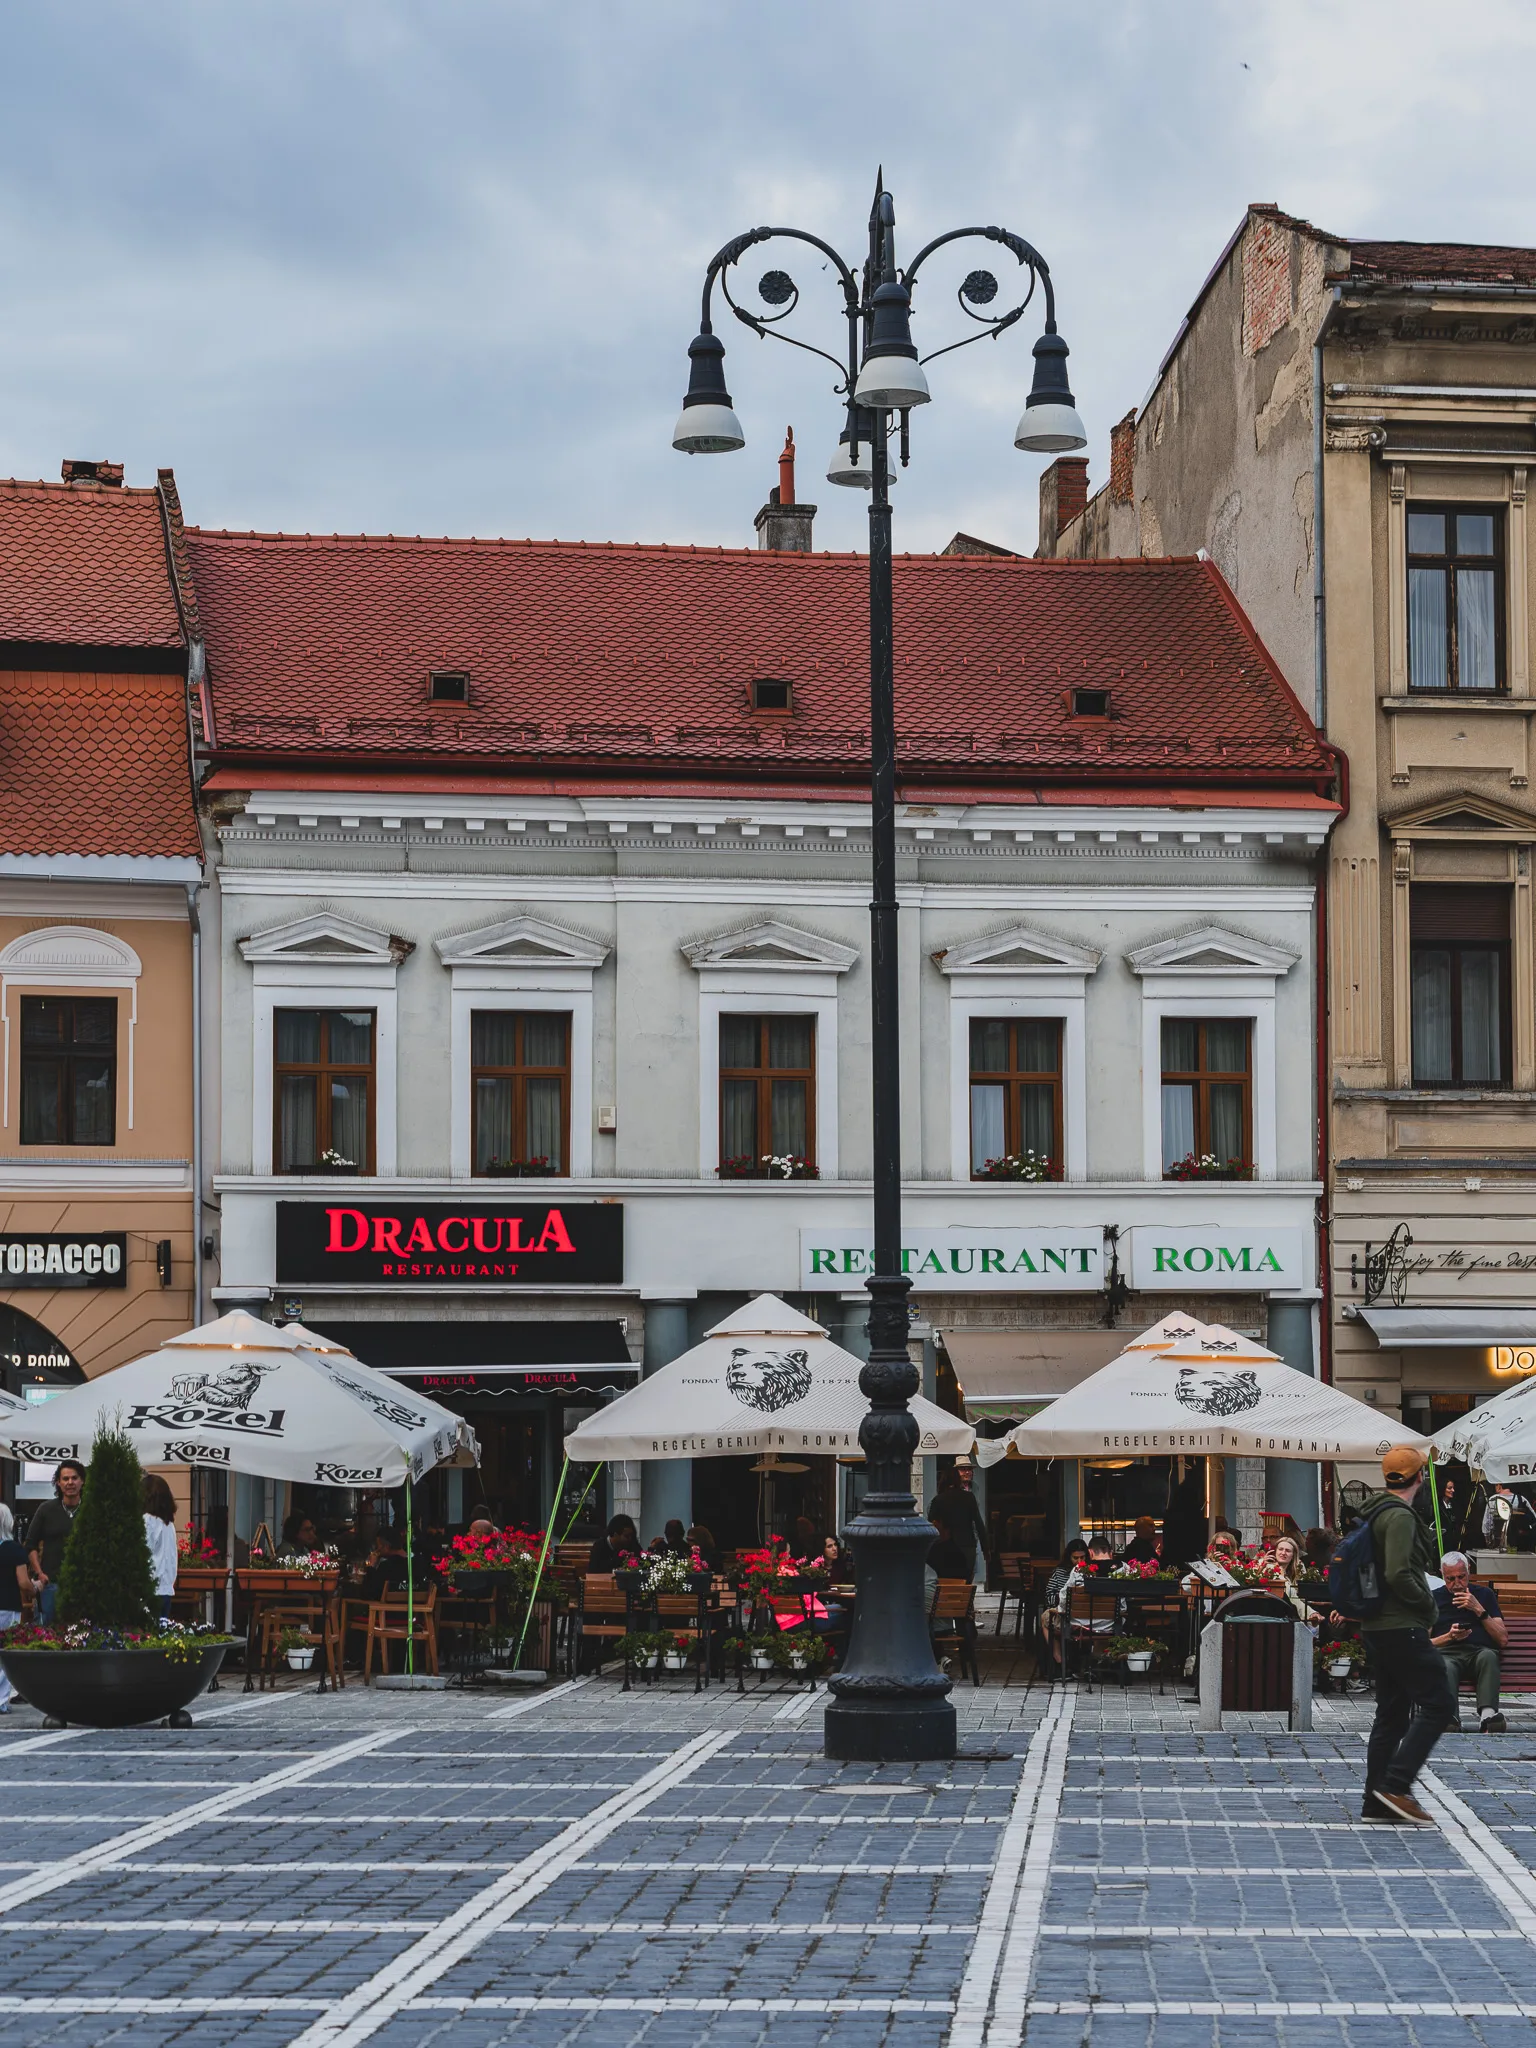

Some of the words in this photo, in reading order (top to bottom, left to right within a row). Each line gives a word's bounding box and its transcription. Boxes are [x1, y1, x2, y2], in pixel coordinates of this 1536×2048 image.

[382, 1264, 519, 1275] RESTAURANT
[1152, 1247, 1284, 1272] ROMA
[1458, 1255, 1502, 1280] fine
[524, 1373, 578, 1385] DRACULA
[122, 1404, 286, 1434] Kozel
[10, 1440, 80, 1461] Kozel
[162, 1441, 231, 1464] Kozel
[652, 1439, 706, 1452] REGELE
[717, 1436, 758, 1448] BERII
[767, 1432, 785, 1446] ÎN
[802, 1433, 860, 1446] ROMÂ
[1103, 1435, 1158, 1447] REGELE
[1169, 1435, 1210, 1446] BERII
[1220, 1433, 1238, 1446] ÎN
[1255, 1437, 1342, 1453] ROMÂNIA
[314, 1462, 383, 1483] Kozel
